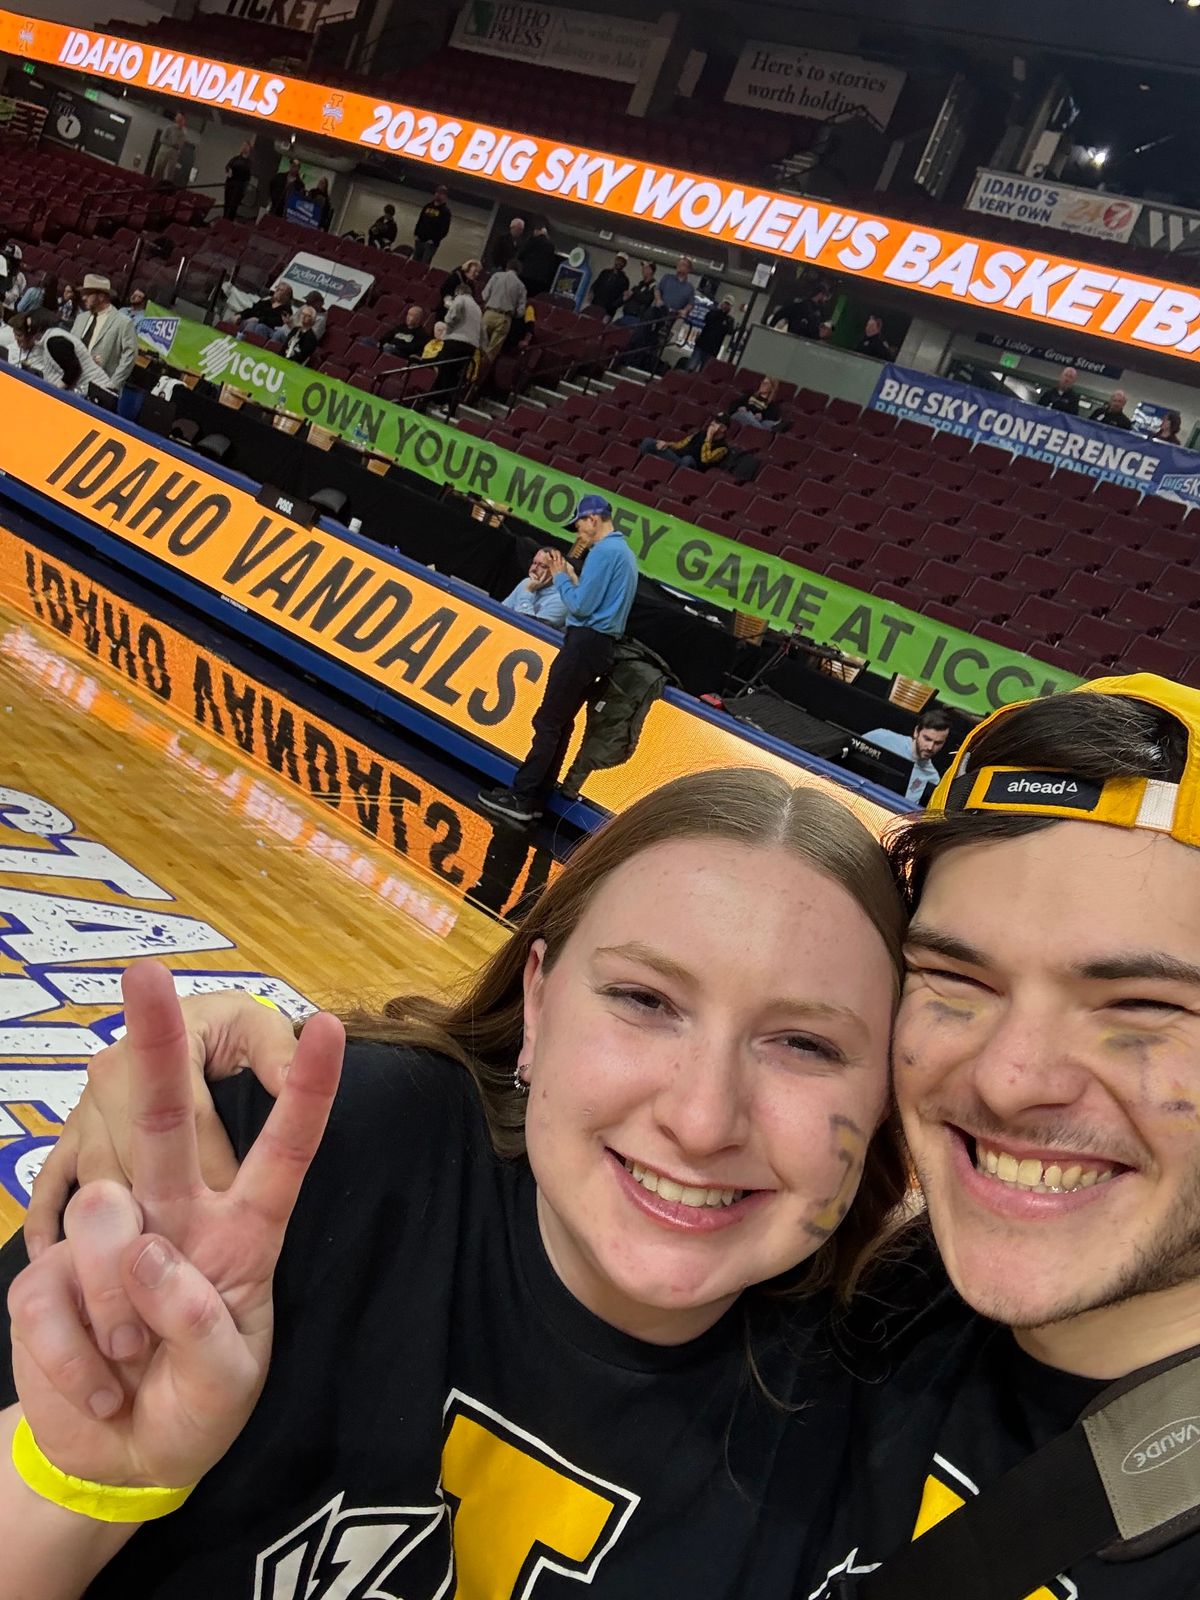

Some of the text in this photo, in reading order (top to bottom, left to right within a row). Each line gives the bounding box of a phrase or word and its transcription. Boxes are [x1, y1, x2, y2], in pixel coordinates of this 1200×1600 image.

[495, 4, 550, 28] IDAHO
[488, 22, 543, 48] PRESS
[750, 52, 888, 93] Here's to stories
[748, 83, 860, 114] worth holdin
[58, 31, 144, 80] IDAHO
[147, 51, 285, 116] VANDALS
[359, 105, 463, 163] 2026
[457, 128, 538, 183] BIG
[535, 148, 637, 204] SKY
[632, 168, 890, 270] WOMEN'S
[979, 196, 1053, 223] VERY OWN
[983, 178, 1059, 206] IDAHO'S
[992, 335, 1004, 345] To
[1006, 338, 1033, 355] Lobby
[1044, 347, 1073, 363] Grove
[1074, 357, 1106, 374] Street
[879, 378, 925, 410] BIG
[922, 391, 979, 424] SKY
[978, 408, 1160, 480] CONFERENCE
[230, 352, 1059, 709] ICCU OWN YOUR MOEY GAME AT ICC
[47, 429, 231, 557] IDAHO
[222, 515, 543, 727] VANDALS
[1007, 778, 1066, 795] ahead
